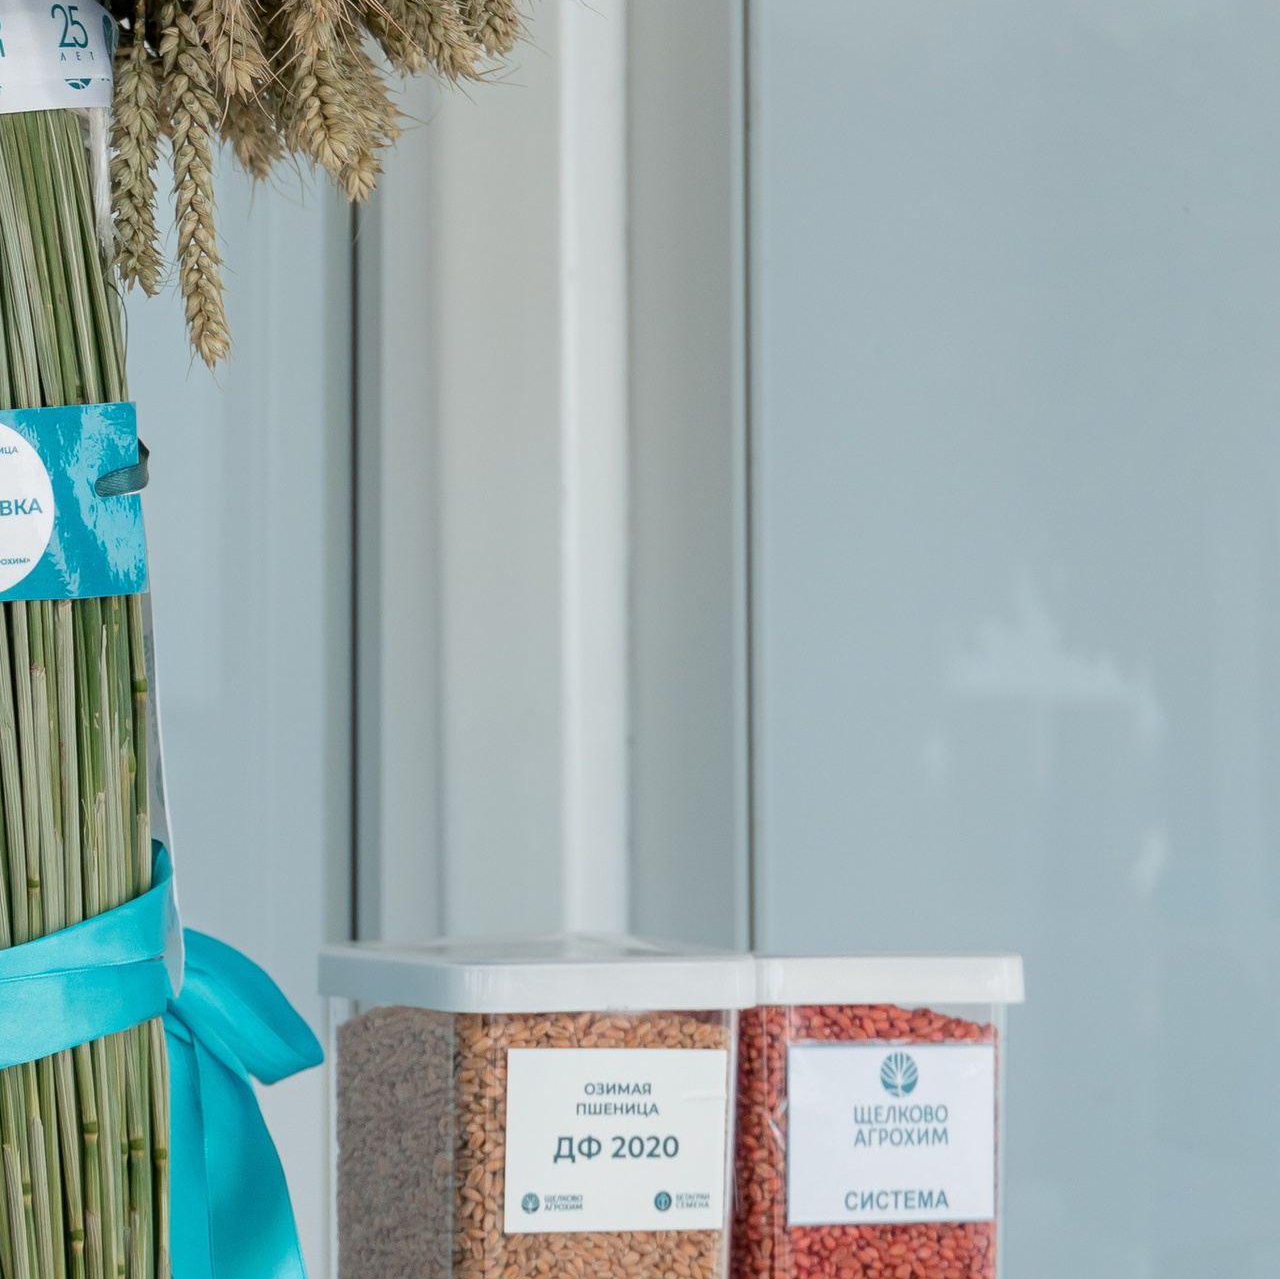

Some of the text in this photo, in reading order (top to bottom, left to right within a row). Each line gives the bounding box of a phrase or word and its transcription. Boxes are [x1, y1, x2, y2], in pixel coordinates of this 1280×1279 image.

[51, 3, 89, 49] 25
[584, 1082, 652, 1096] ОЗИМАЯ
[576, 1102, 659, 1117] ПШЕНИЦА
[853, 1104, 949, 1125] ЩЕЛКОВО
[853, 1127, 949, 1148] АГРОХИМ
[553, 1135, 680, 1164] ДФ 2020
[844, 1189, 950, 1210] СИСТЕМА
